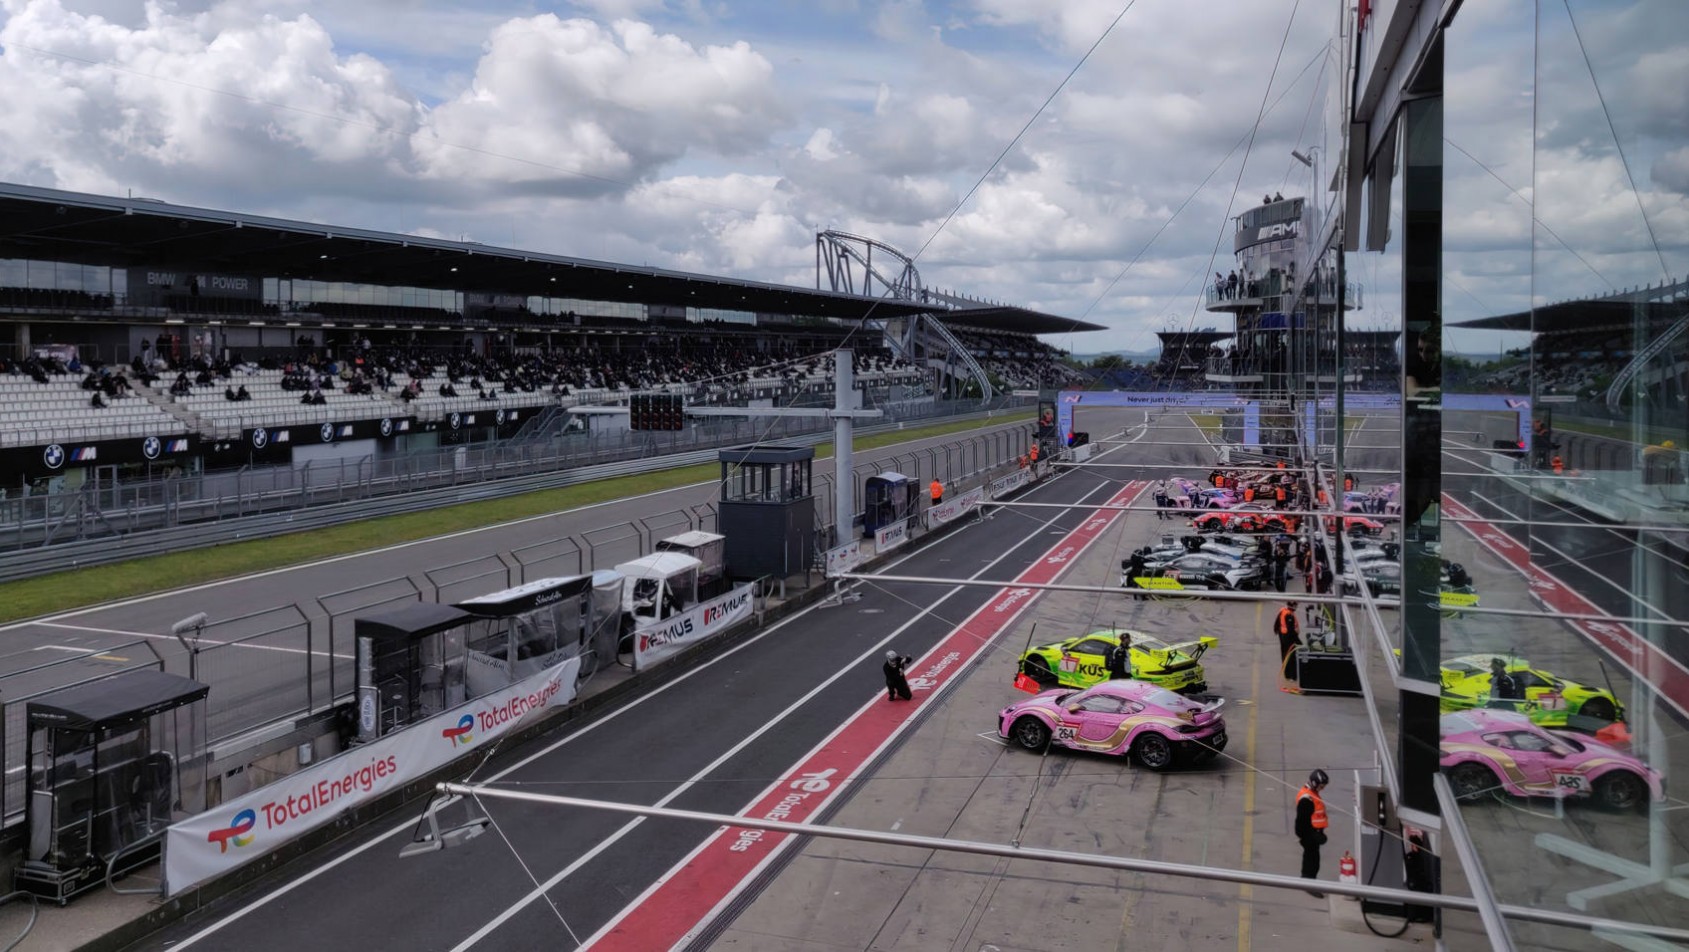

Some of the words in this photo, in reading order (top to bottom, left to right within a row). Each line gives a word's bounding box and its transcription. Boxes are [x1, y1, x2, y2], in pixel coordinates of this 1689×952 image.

[147, 271, 176, 286] BMW
[212, 276, 248, 290] POWER
[1150, 396, 1164, 404] just
[79, 446, 97, 461] M
[646, 617, 694, 648] REMUS
[478, 677, 563, 733] TotalEnergies
[1058, 727, 1074, 739] 264
[261, 755, 397, 830] TotalEnergies
